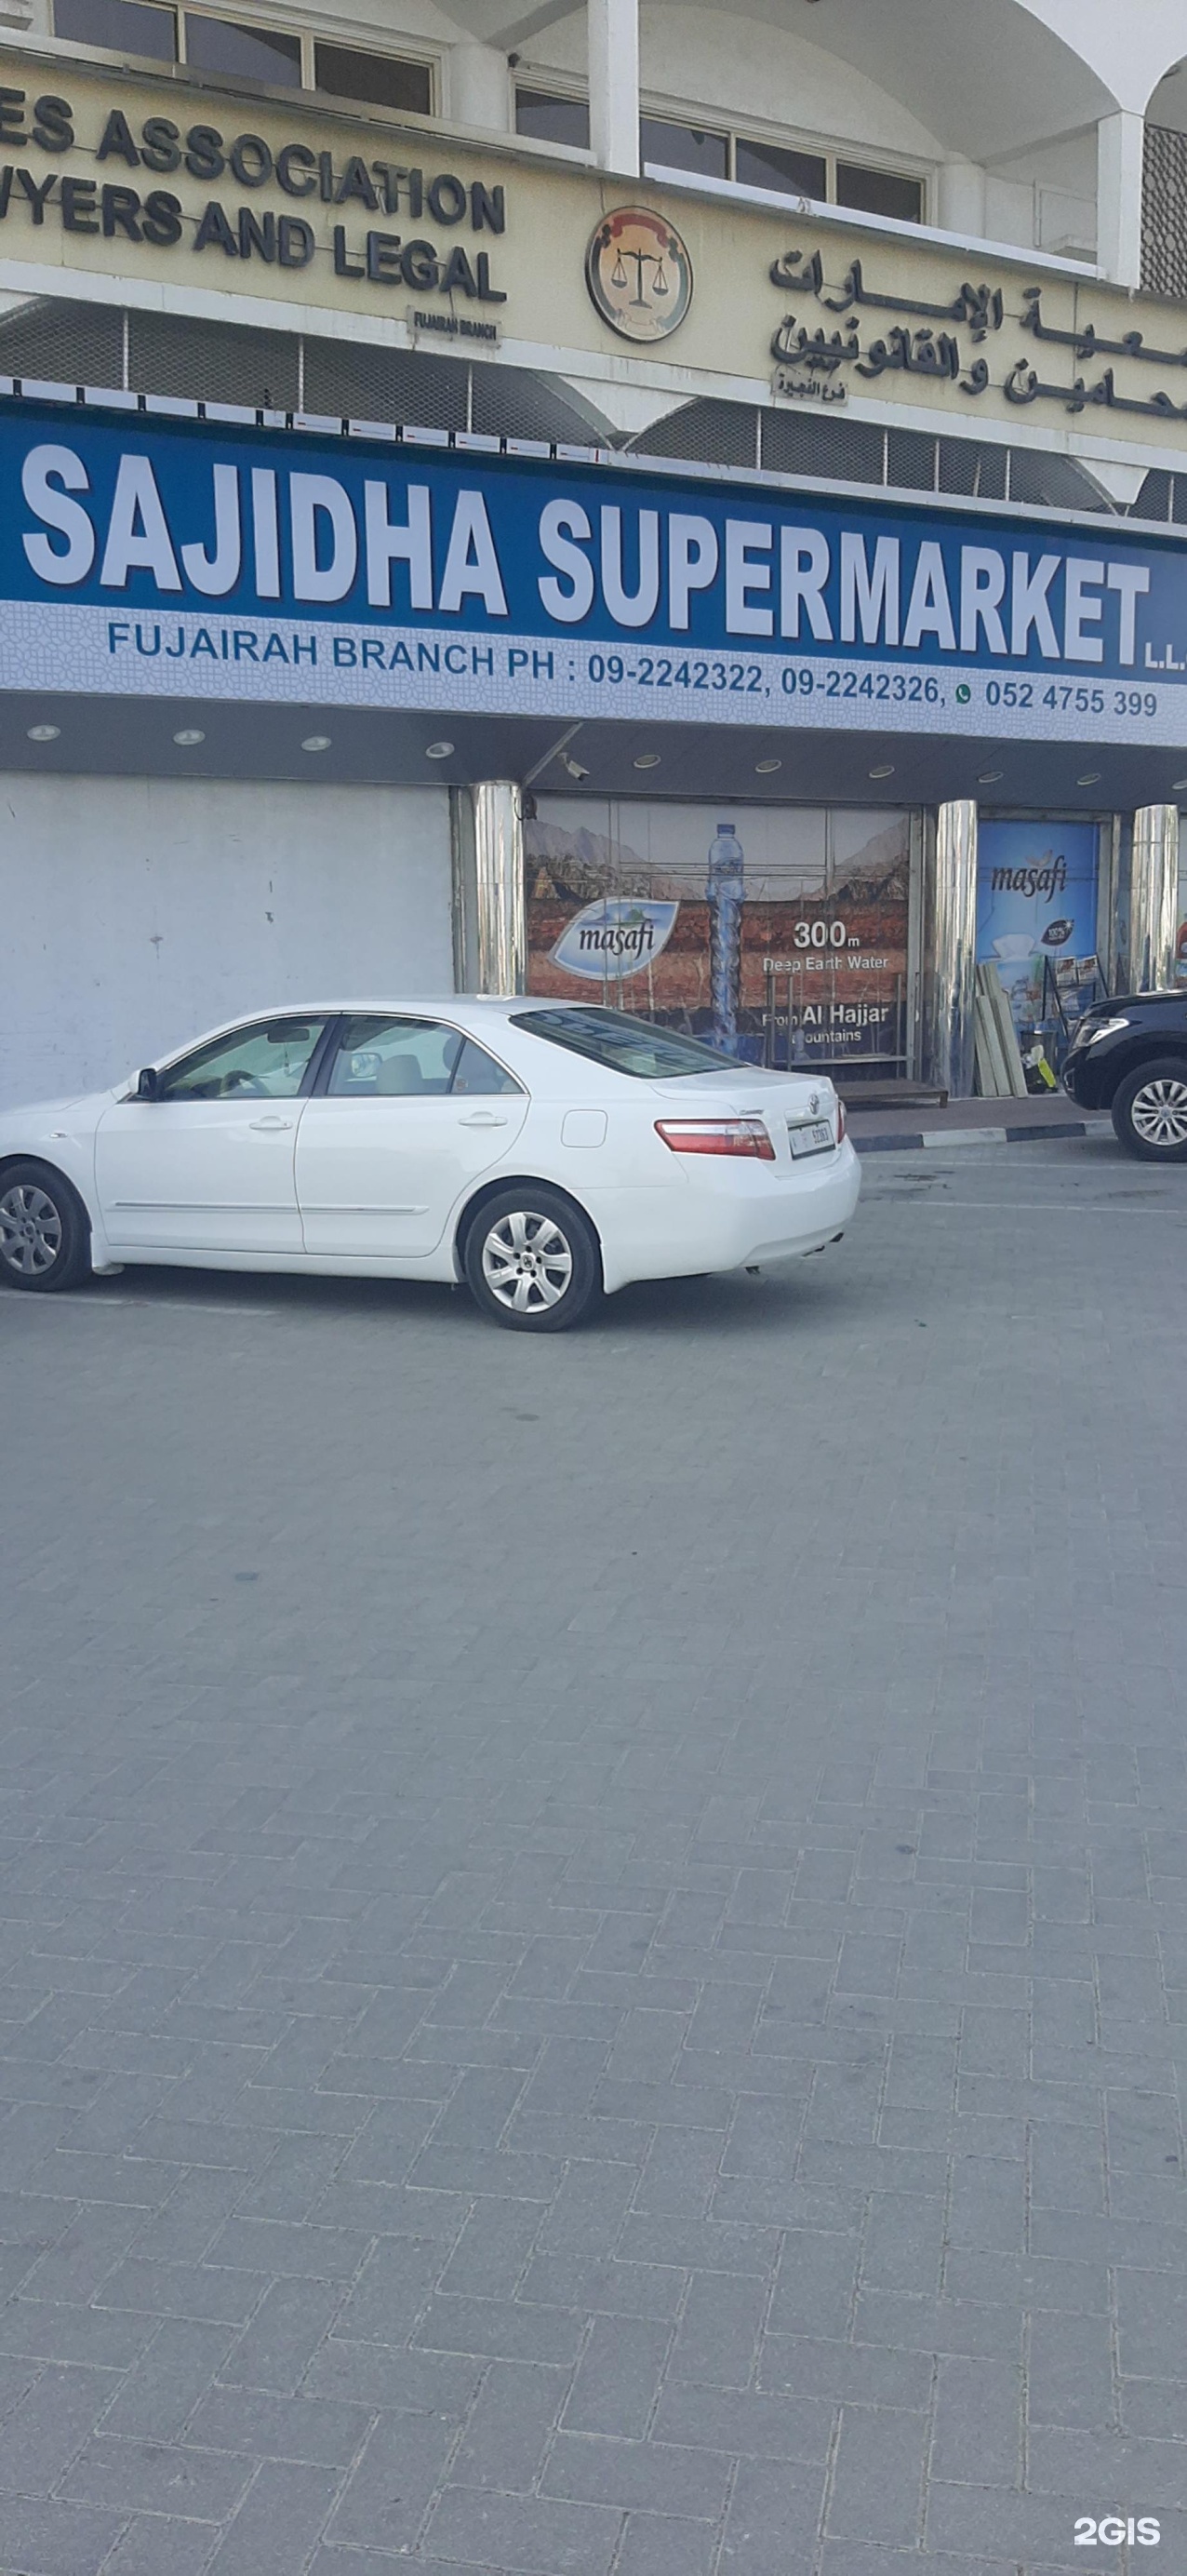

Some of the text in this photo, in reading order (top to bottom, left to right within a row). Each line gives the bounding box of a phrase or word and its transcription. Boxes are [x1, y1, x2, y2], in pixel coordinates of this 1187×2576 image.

[0, 87, 506, 235] ES ASSOCIATION
[193, 200, 315, 268] AND
[334, 224, 508, 302] LEGAL
[1020, 287, 1187, 368] عية
[1004, 357, 1187, 419] حامين
[21, 444, 1187, 670] SAJIDHA SUPERMARKET L.L.
[107, 623, 318, 665] FUJAIRAH
[333, 637, 494, 676] BRANCH
[507, 648, 554, 680] PH
[588, 653, 771, 694] 09-2242322,
[780, 667, 946, 708] 09-2242326,
[985, 680, 1034, 708] 052
[1043, 685, 1105, 714] 4755
[1114, 691, 1157, 717] 399
[991, 854, 1067, 904] masafi
[580, 918, 655, 960] masafi
[763, 955, 889, 973] Deep Earth Water
[803, 1005, 822, 1025] Al
[830, 1004, 889, 1027] Hajjar
